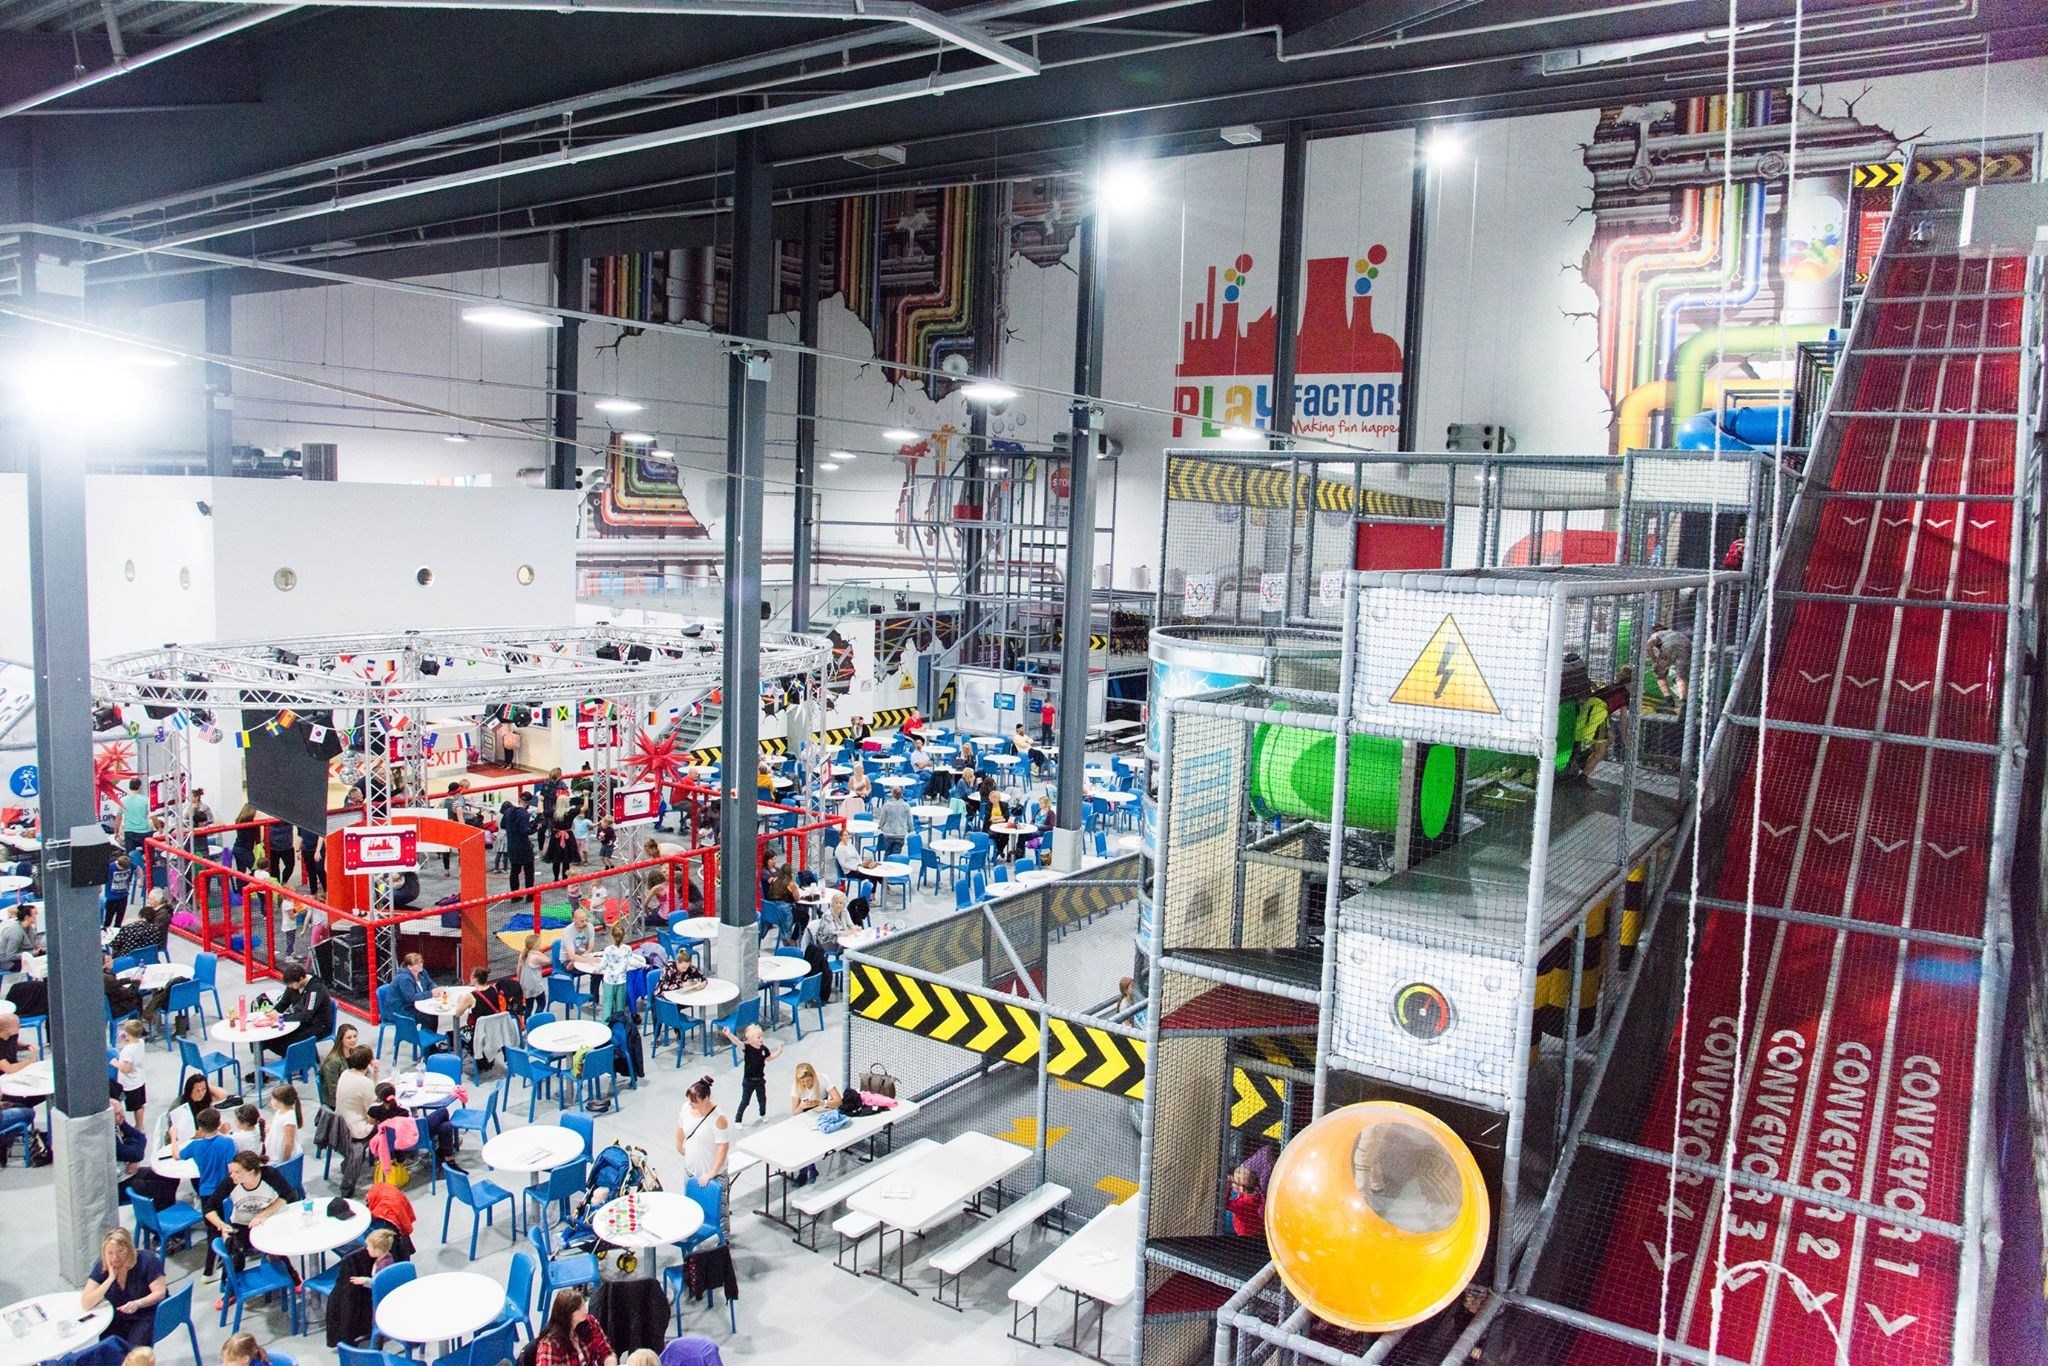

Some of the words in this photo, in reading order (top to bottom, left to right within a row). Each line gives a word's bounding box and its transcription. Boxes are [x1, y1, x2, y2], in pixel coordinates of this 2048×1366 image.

[1292, 417, 1335, 438] Making
[1338, 419, 1358, 435] fun
[1361, 421, 1400, 438] happe
[1657, 1195, 1695, 1221] 4
[1727, 1213, 1768, 1241] 3
[1797, 1232, 1841, 1260] 2
[1874, 1258, 1920, 1278] 1
